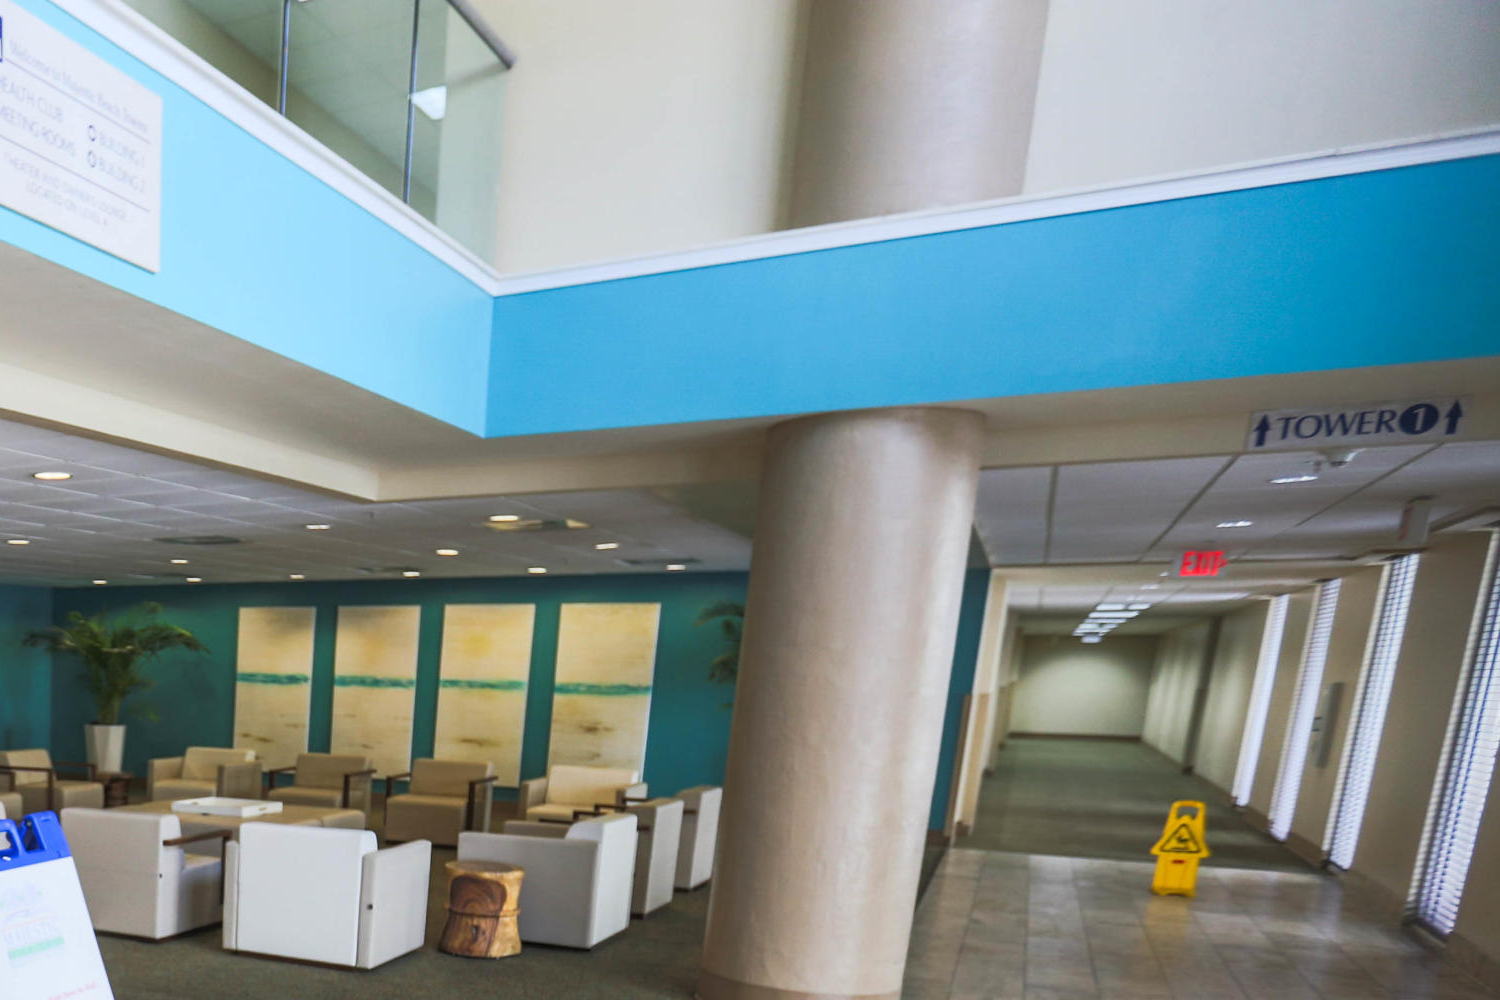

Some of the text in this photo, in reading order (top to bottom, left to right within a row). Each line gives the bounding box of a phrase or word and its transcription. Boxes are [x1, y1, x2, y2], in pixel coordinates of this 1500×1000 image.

[37, 97, 64, 123] CLUB
[42, 126, 76, 158] ROOMS
[99, 131, 139, 165] BUILDING
[99, 157, 139, 191] BUILDING
[1277, 409, 1397, 441] TOWER
[1179, 550, 1223, 577] EXIT
